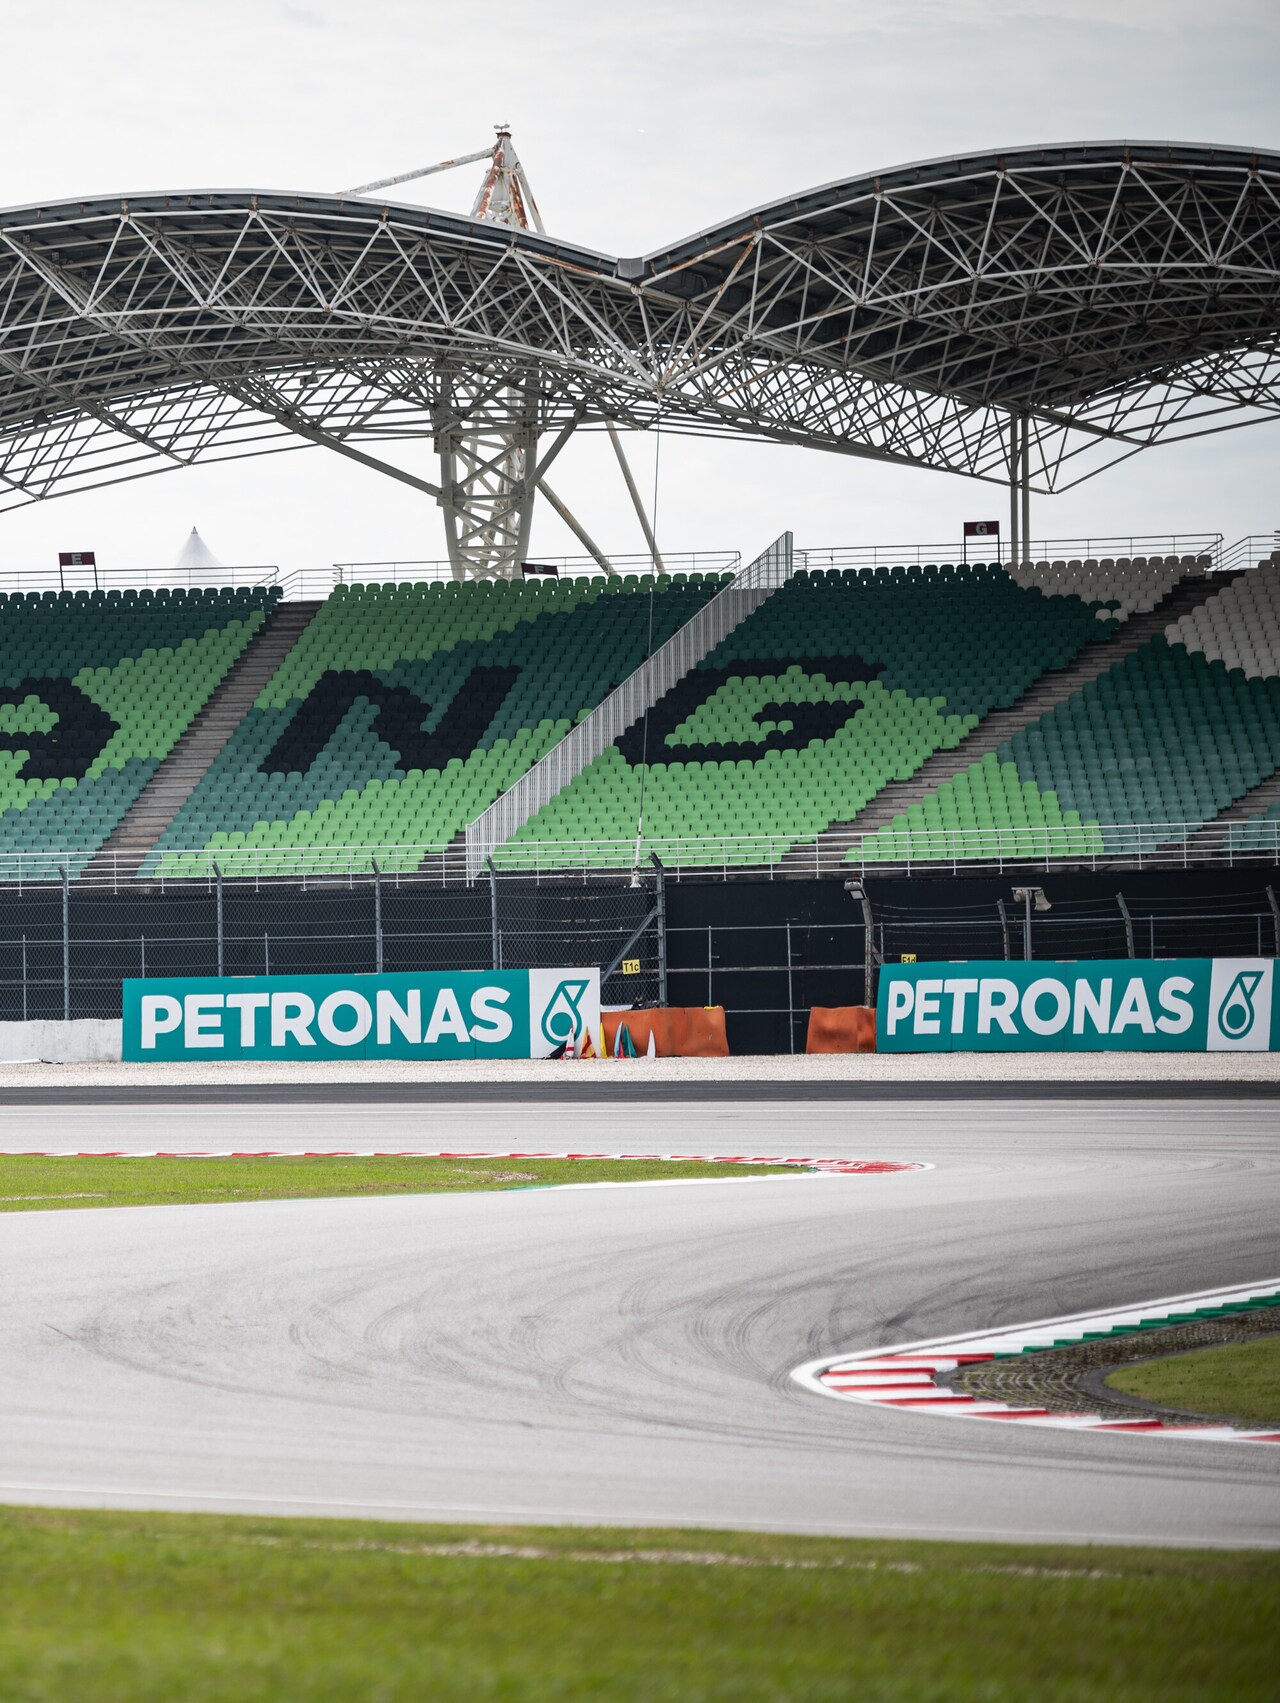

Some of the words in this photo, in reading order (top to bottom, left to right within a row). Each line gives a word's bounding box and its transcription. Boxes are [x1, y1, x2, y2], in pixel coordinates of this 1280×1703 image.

[976, 522, 987, 535] G
[71, 553, 82, 565] E
[623, 962, 639, 972] T1c
[886, 976, 1195, 1036] PETRONAS
[140, 986, 513, 1049] PETRONAS
